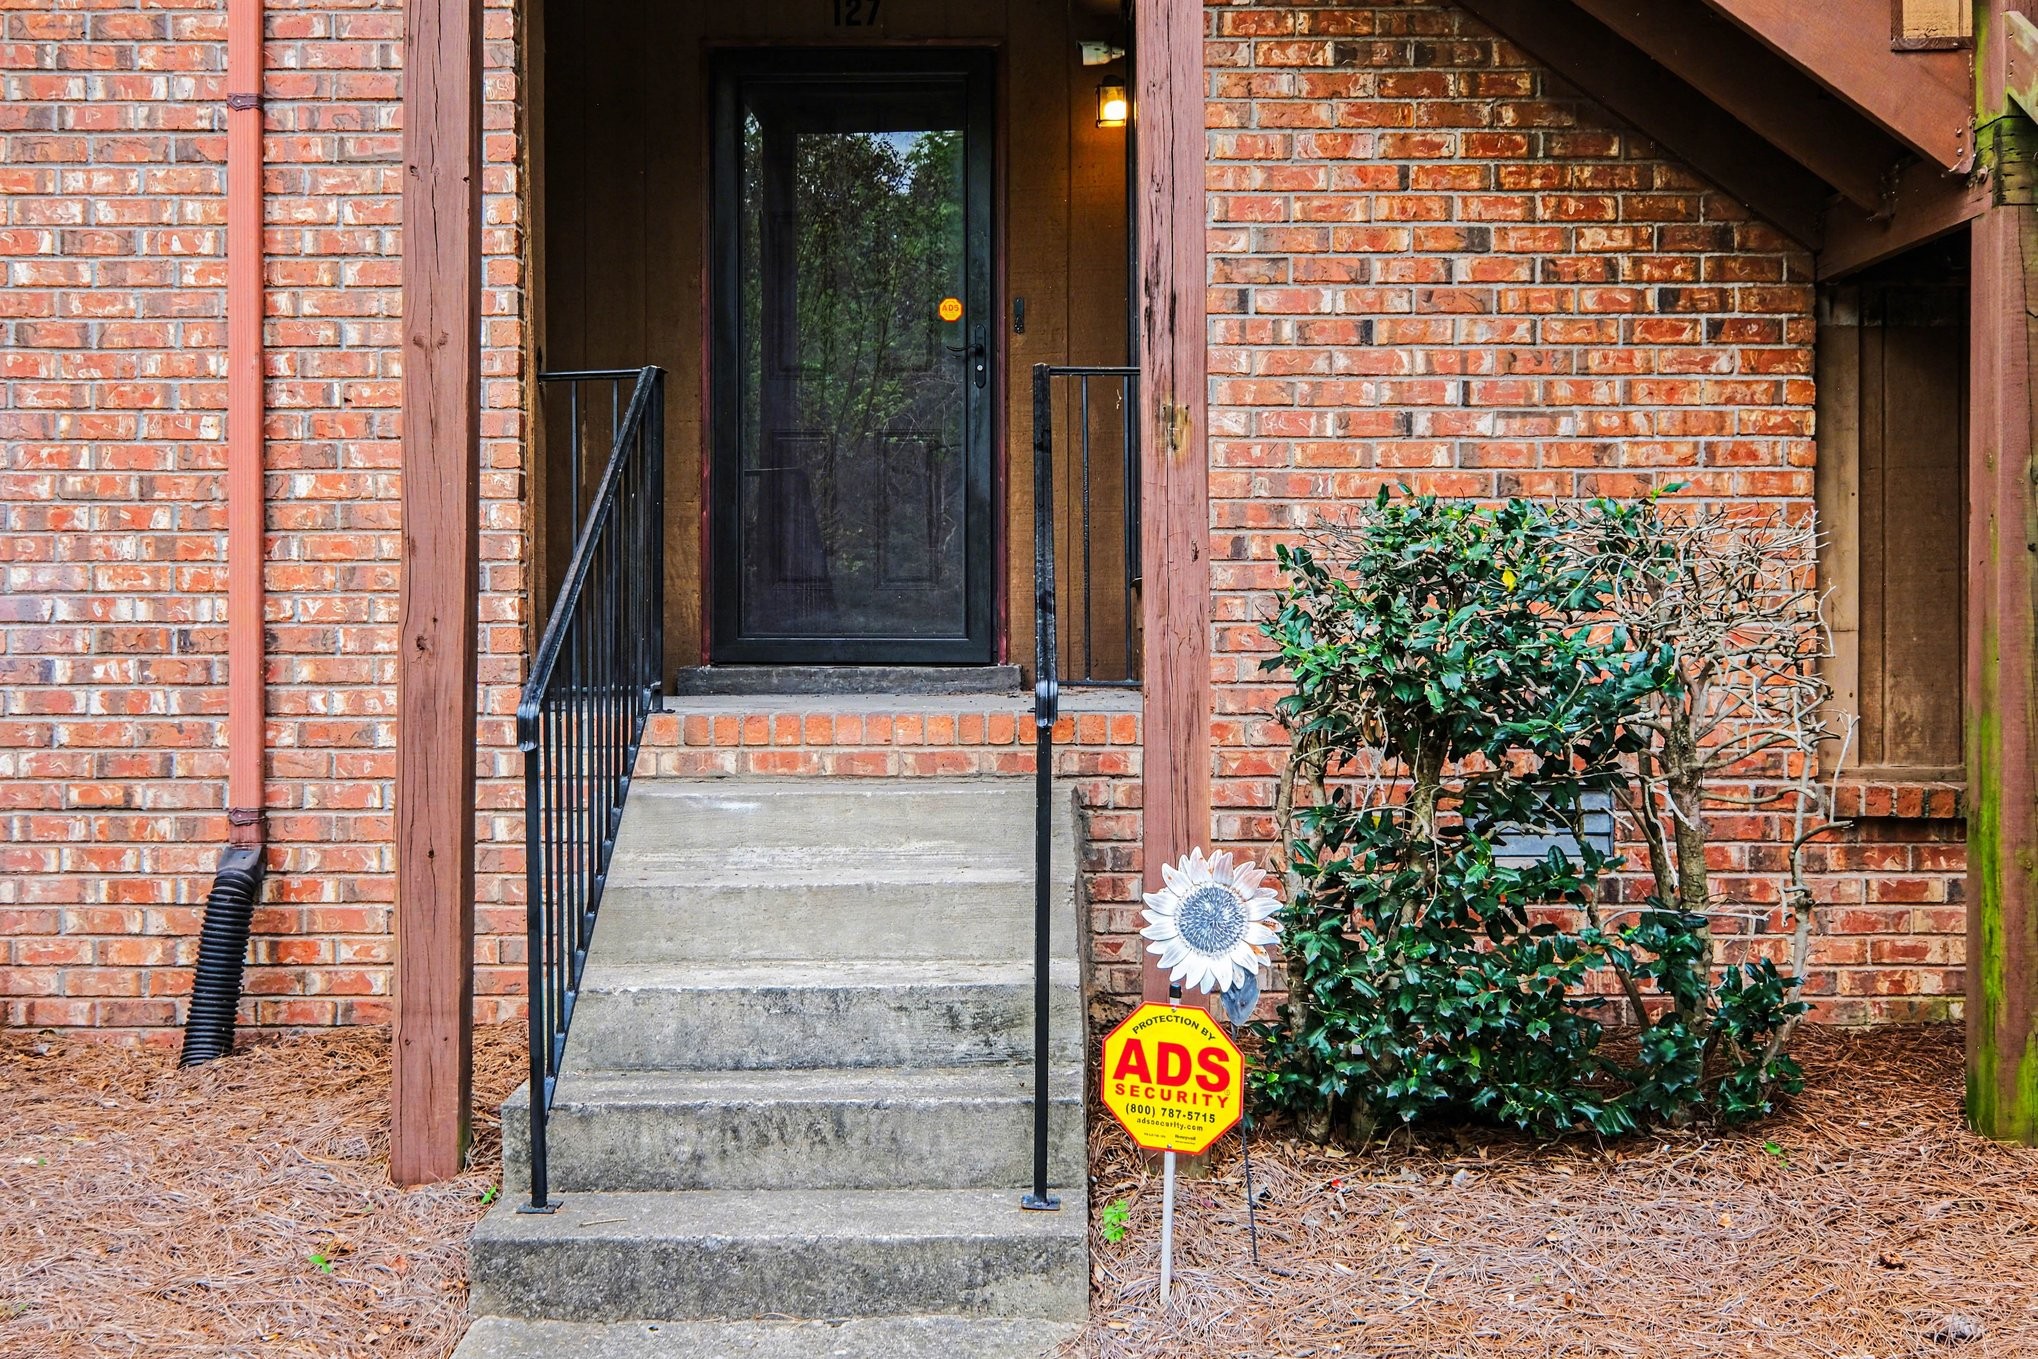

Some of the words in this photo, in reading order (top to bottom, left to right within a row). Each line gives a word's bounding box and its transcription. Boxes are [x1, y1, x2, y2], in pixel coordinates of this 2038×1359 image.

[834, 0, 880, 26] 127
[1132, 1014, 1200, 1034] PROTECTION
[1200, 1027, 1216, 1041] BY
[1112, 1037, 1231, 1093] ADS
[1115, 1083, 1229, 1109] SECURITY
[1126, 1103, 1156, 1118] (800)
[1161, 1107, 1216, 1124] 787-5715
[1136, 1117, 1203, 1132] adssecurity.com
